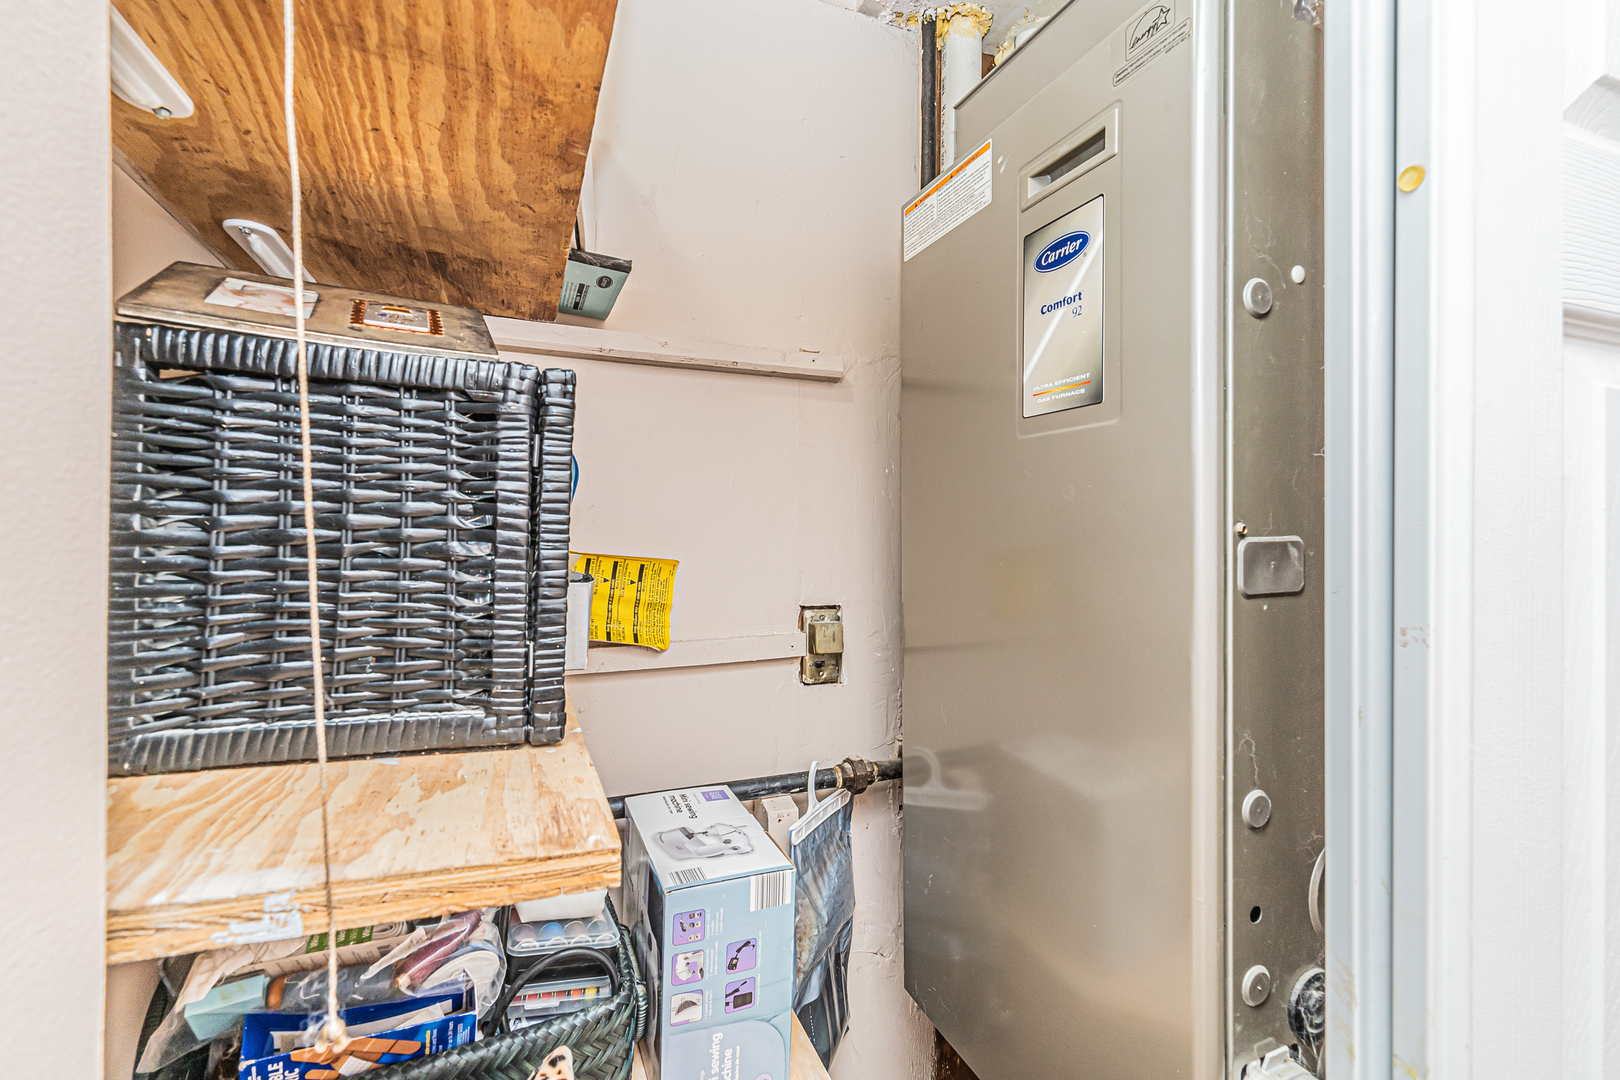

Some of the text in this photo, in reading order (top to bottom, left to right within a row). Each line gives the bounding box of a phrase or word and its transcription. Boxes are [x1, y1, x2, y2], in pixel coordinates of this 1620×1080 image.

[1041, 238, 1083, 266] Carrier
[1040, 291, 1083, 315] Comfort
[1072, 305, 1083, 318] 92
[1033, 372, 1091, 391] ULTRA EFFICIENT
[1036, 388, 1086, 403] GAS FURNACE
[669, 795, 683, 813] machine
[684, 803, 698, 819] sewing
[709, 1032, 723, 1074] sewing
